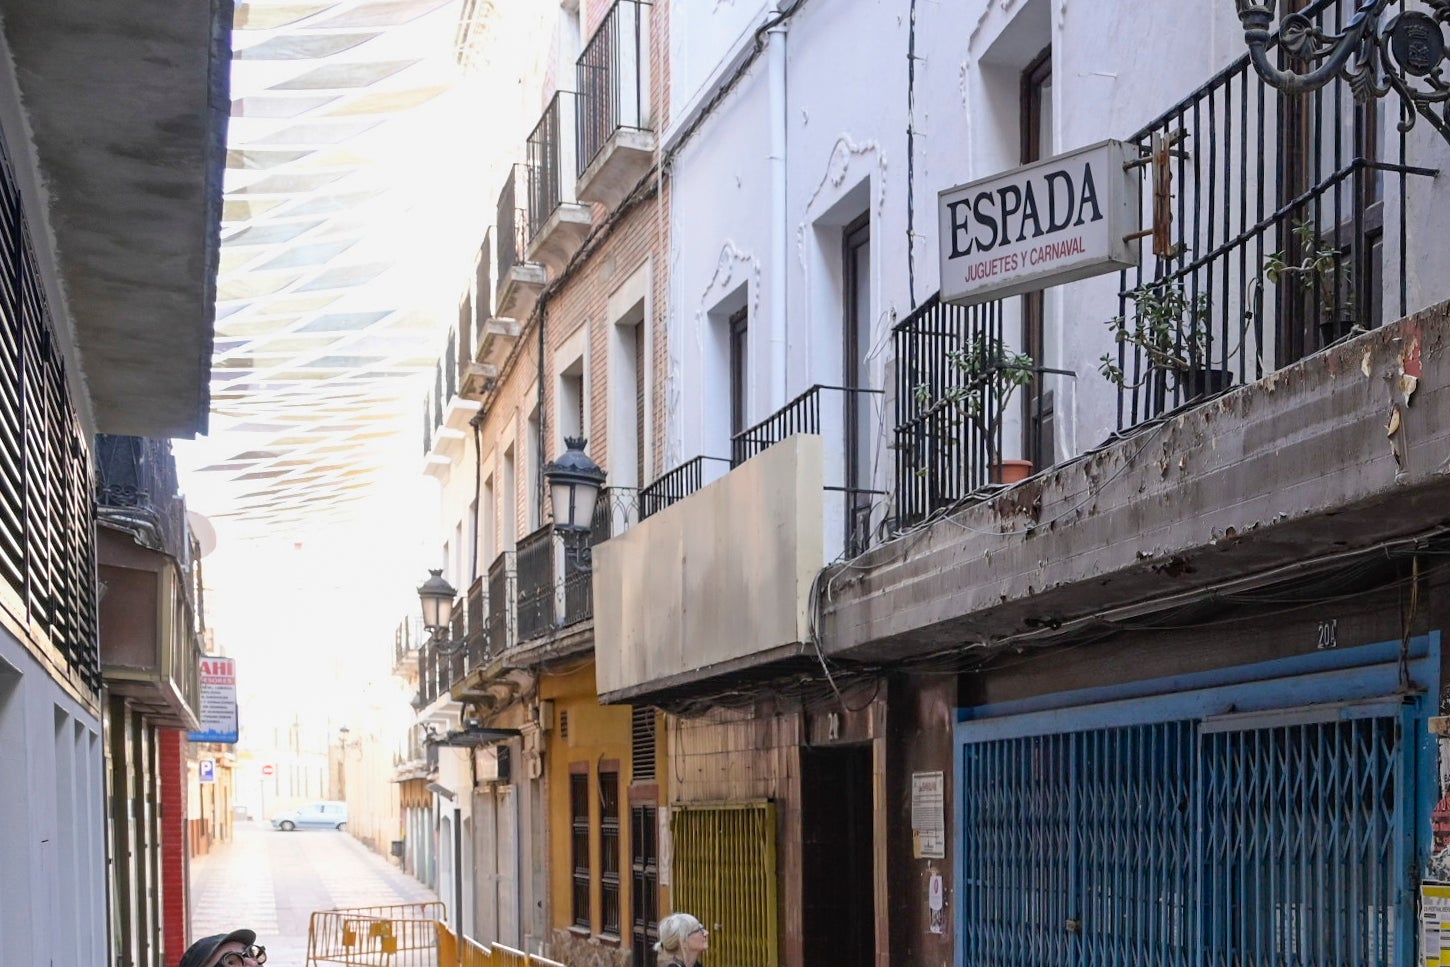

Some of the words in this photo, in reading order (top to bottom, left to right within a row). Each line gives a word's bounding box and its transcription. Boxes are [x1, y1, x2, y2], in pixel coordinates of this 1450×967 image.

[947, 162, 1103, 260] ESPADA
[964, 253, 1018, 283] JUGUETES
[1019, 250, 1028, 265] Y
[1029, 236, 1086, 265] CARNAVAL
